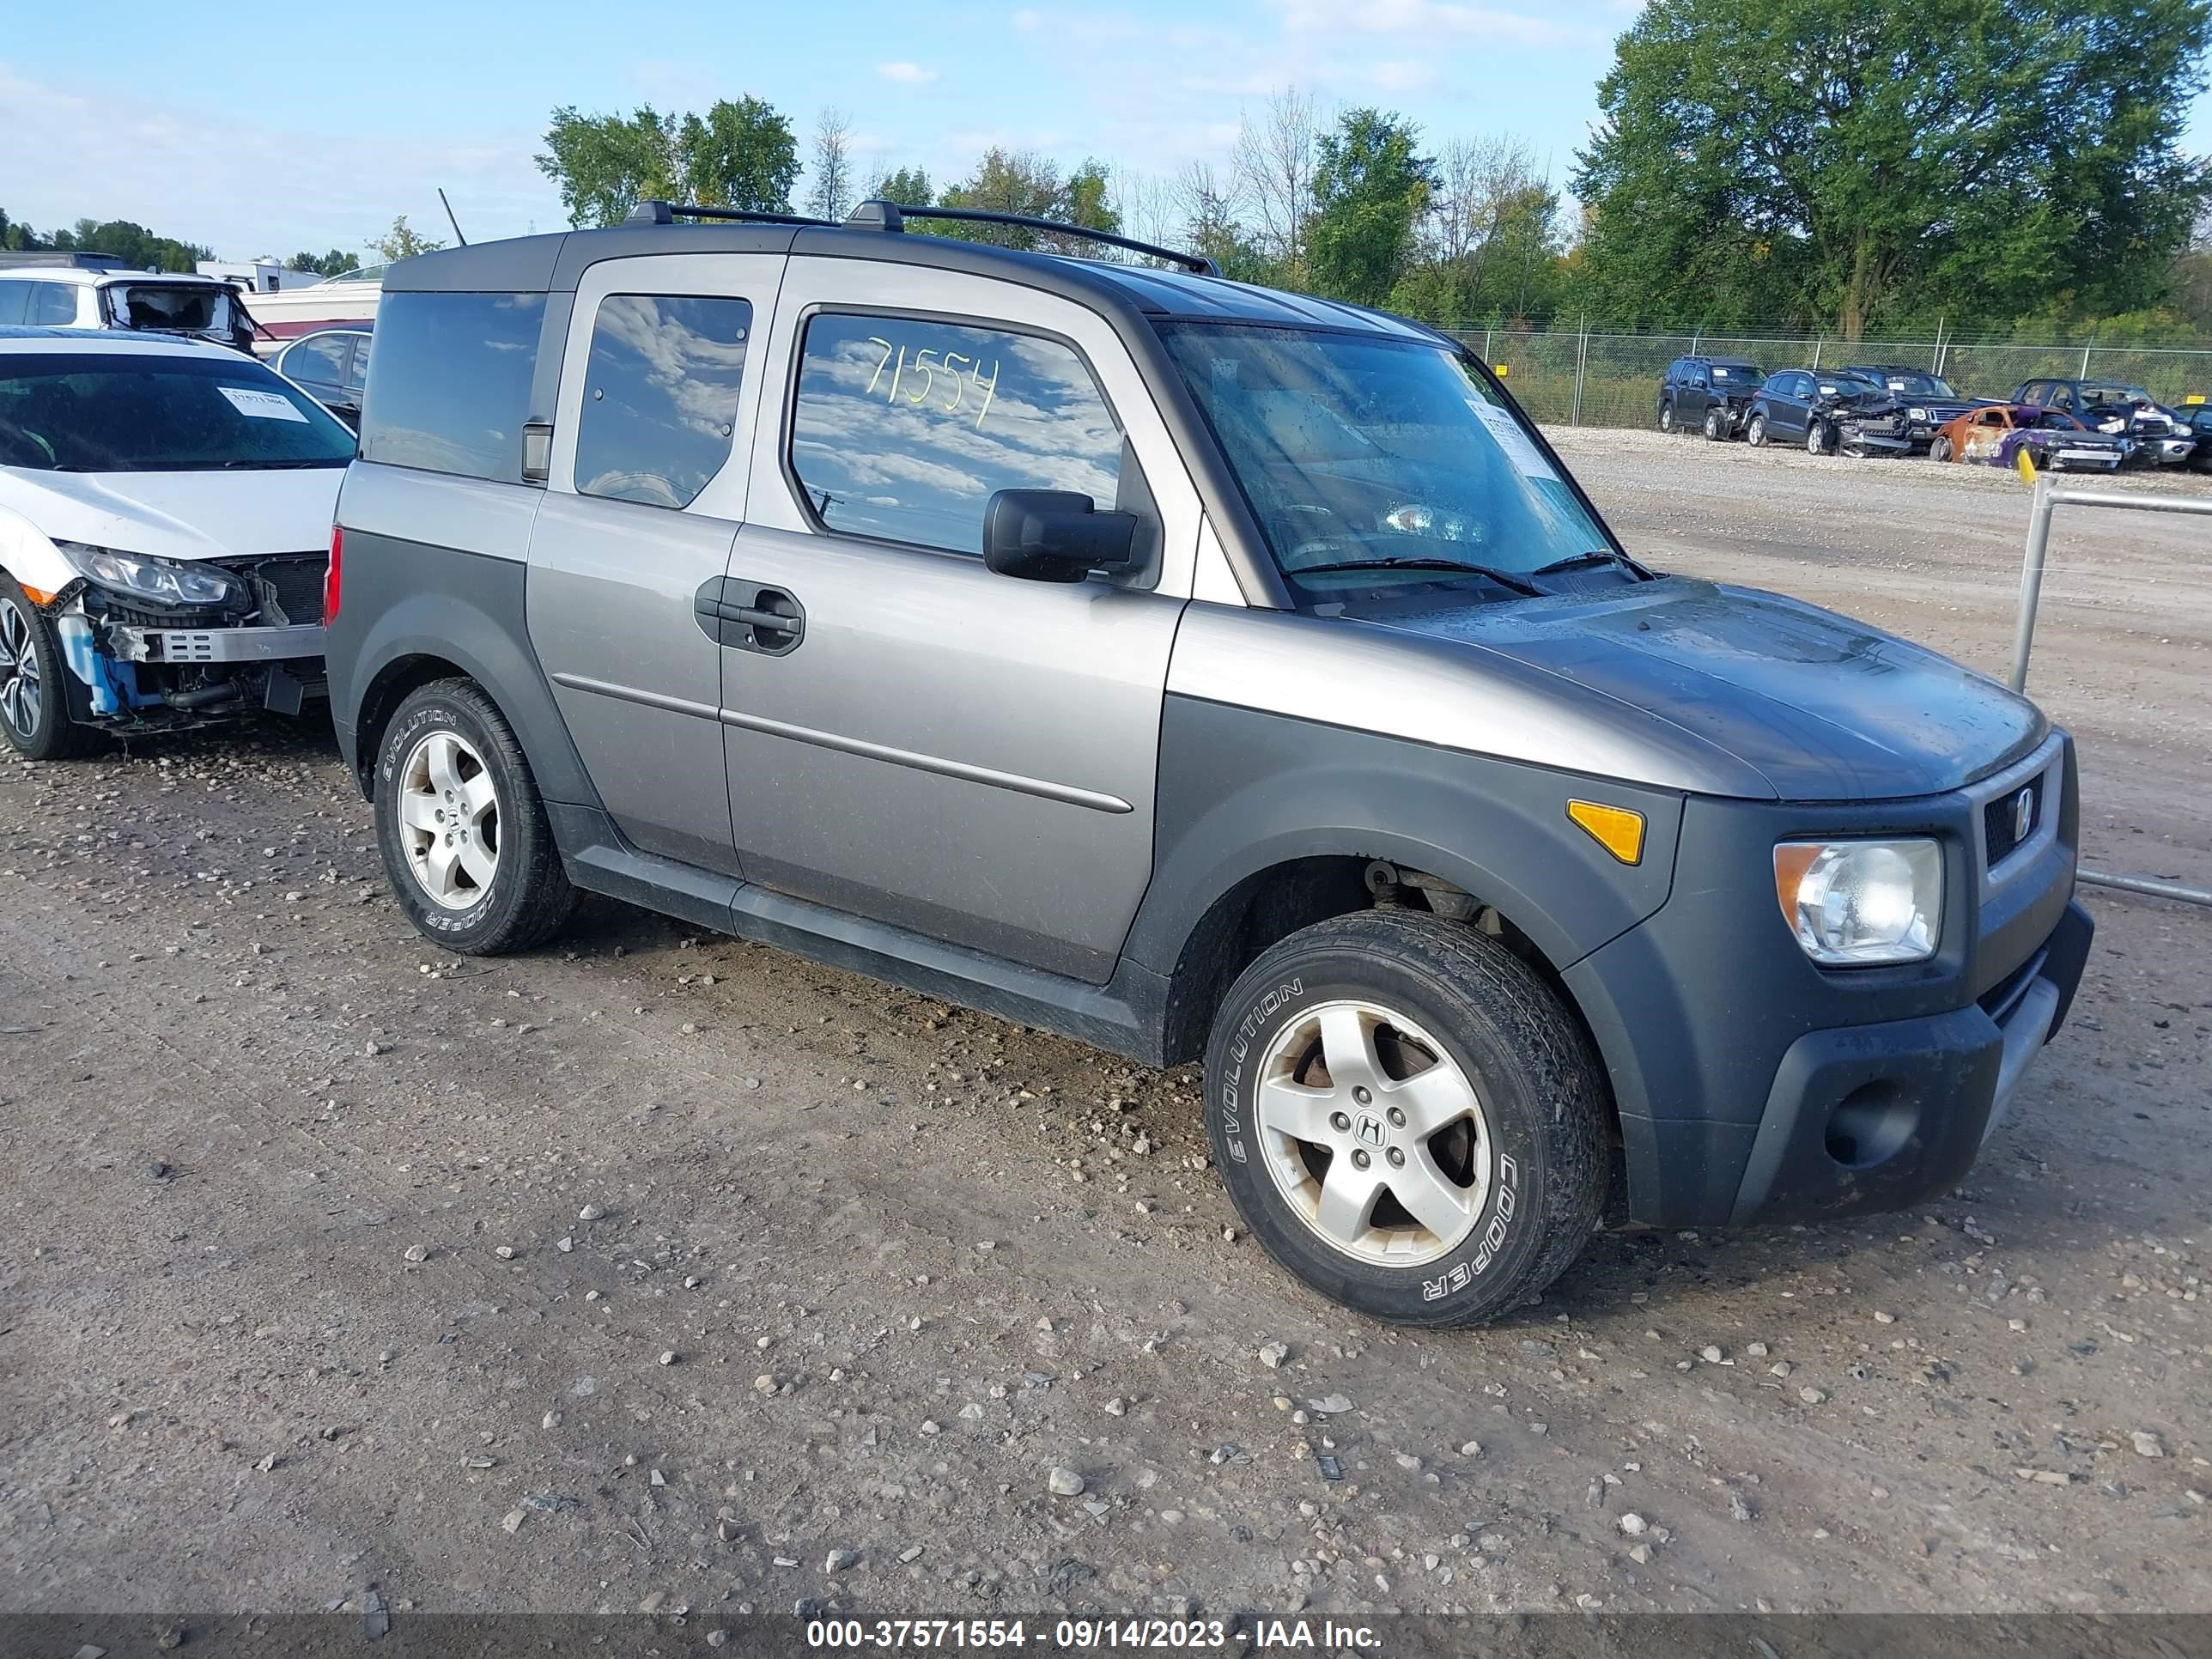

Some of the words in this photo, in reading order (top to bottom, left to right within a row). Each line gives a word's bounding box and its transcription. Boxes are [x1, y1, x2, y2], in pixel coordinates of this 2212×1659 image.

[866, 337, 999, 429] 71554
[383, 709, 457, 782] EVOLUTION
[426, 889, 496, 932] COOPER
[1221, 978, 1305, 1164] EVOLUTION
[1422, 1153, 1519, 1302] COOPER
